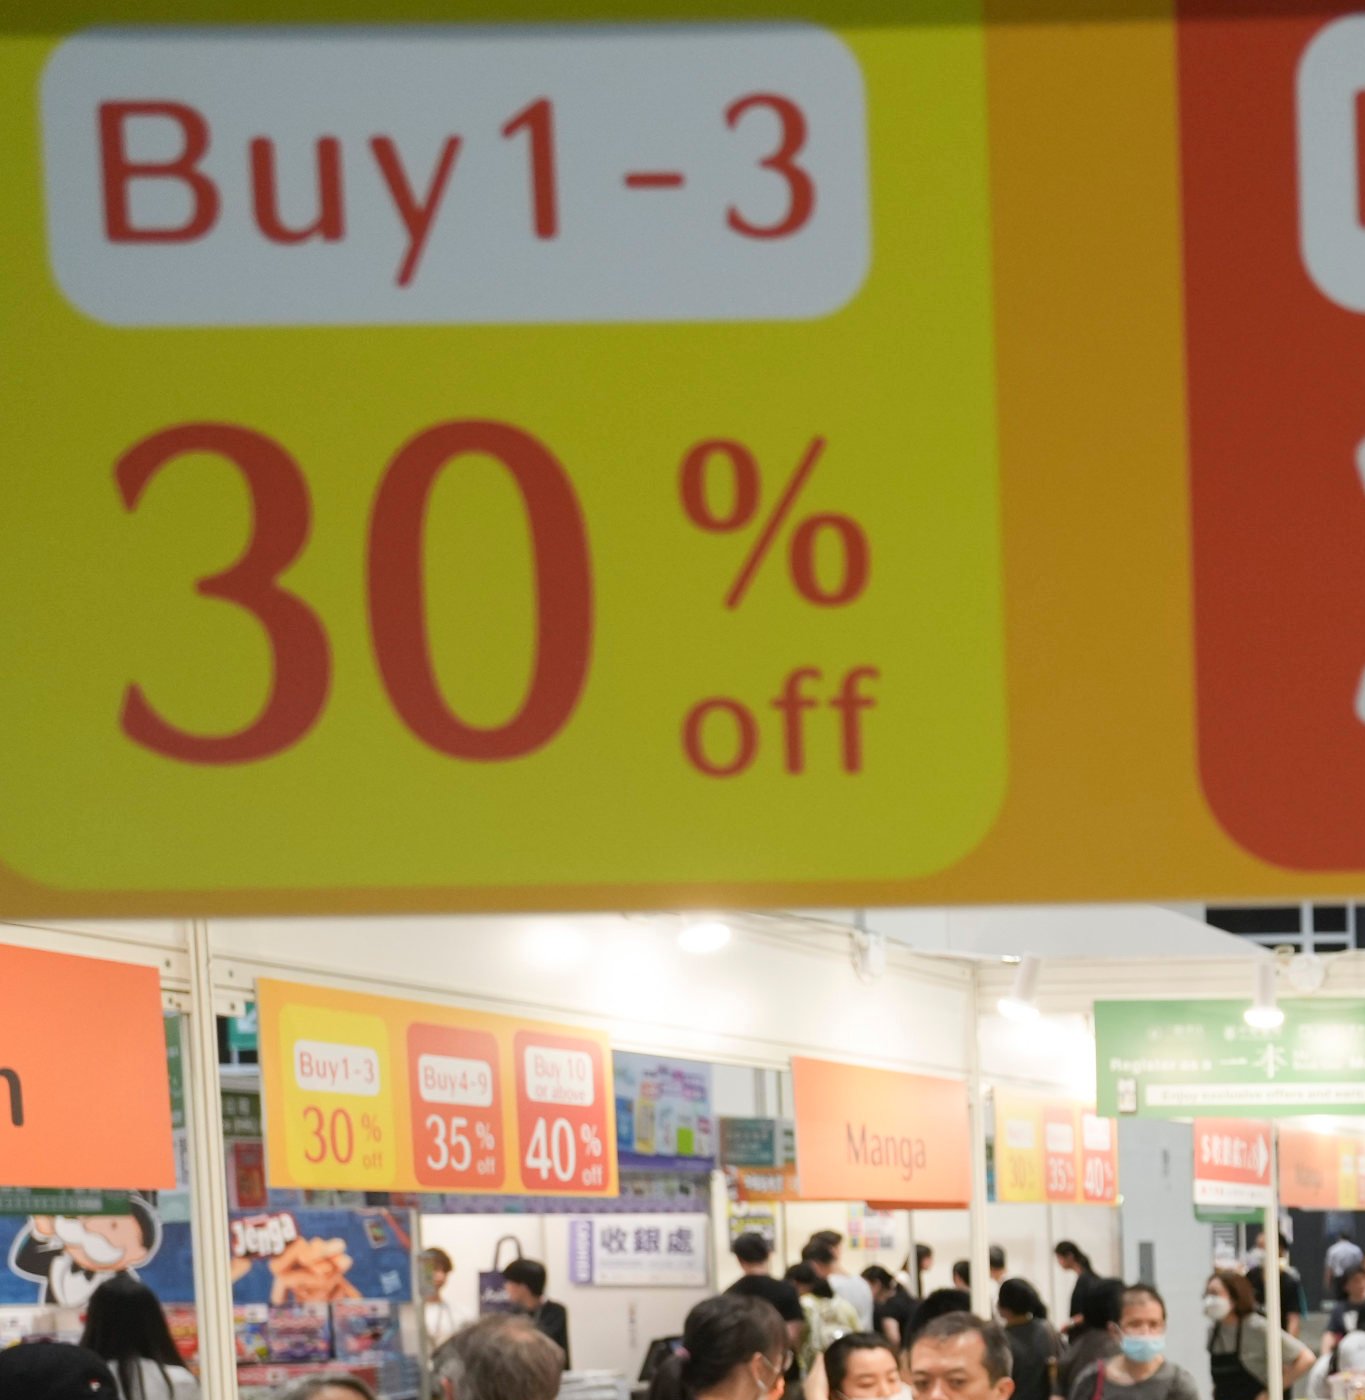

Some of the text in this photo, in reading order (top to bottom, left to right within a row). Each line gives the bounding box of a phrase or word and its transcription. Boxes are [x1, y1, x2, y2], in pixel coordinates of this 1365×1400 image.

[678, 665, 879, 780] off
[535, 1055, 586, 1079] Buy 10
[362, 1153, 383, 1170] off
[846, 1122, 927, 1182] Manga
[477, 1158, 495, 1174] off
[582, 1167, 603, 1185] off
[232, 1213, 298, 1258] Jenga
[600, 1227, 694, 1256] 收銀處
